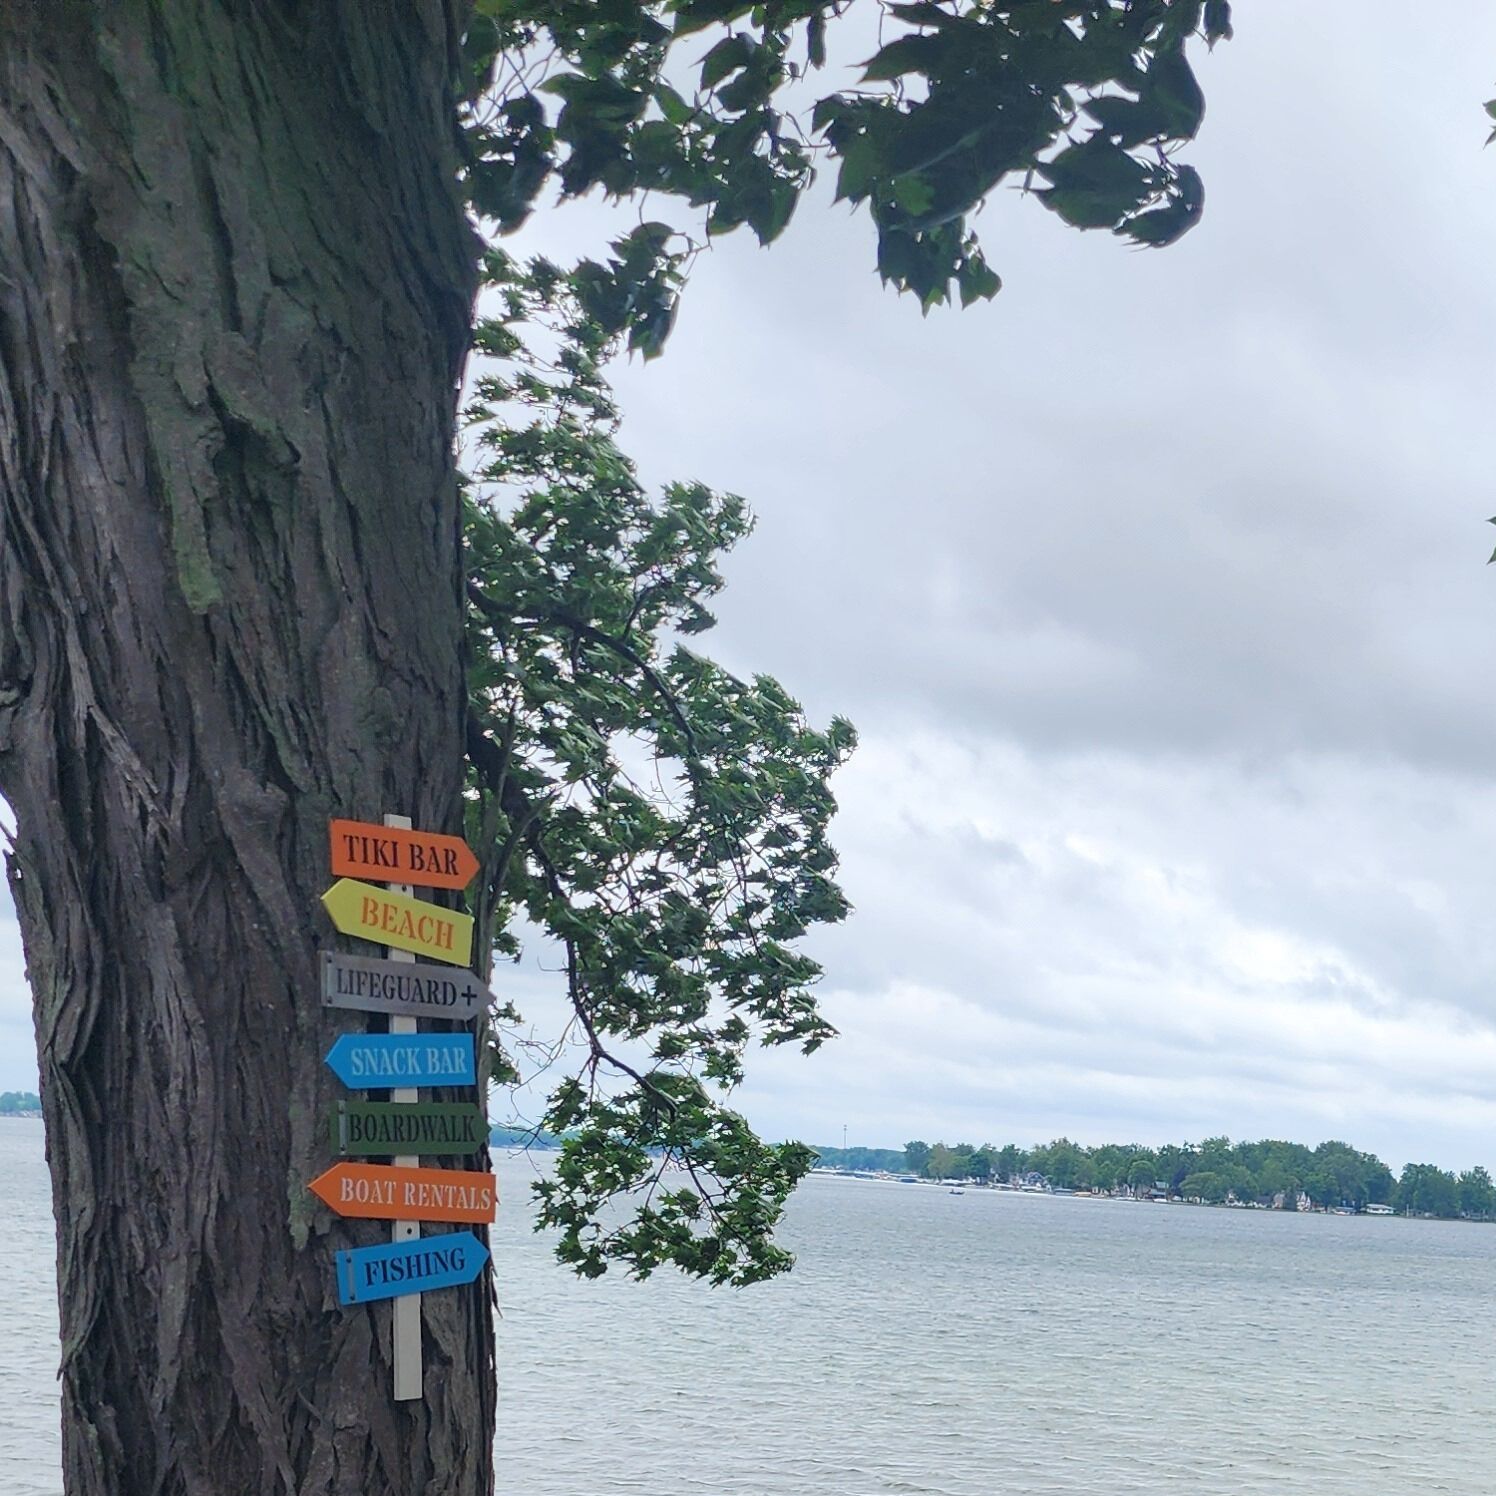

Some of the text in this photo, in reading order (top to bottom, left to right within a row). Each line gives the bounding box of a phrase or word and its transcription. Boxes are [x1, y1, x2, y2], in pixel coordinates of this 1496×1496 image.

[343, 834, 459, 876] TIKI BAR
[361, 896, 455, 950] BEACH
[336, 968, 457, 1006] LIFEGUARD
[351, 1048, 467, 1076] SNACK BAR
[350, 1114, 476, 1142] BOARDWALK
[340, 1177, 491, 1210] BOAT RENTALS
[365, 1248, 465, 1286] FISHING
